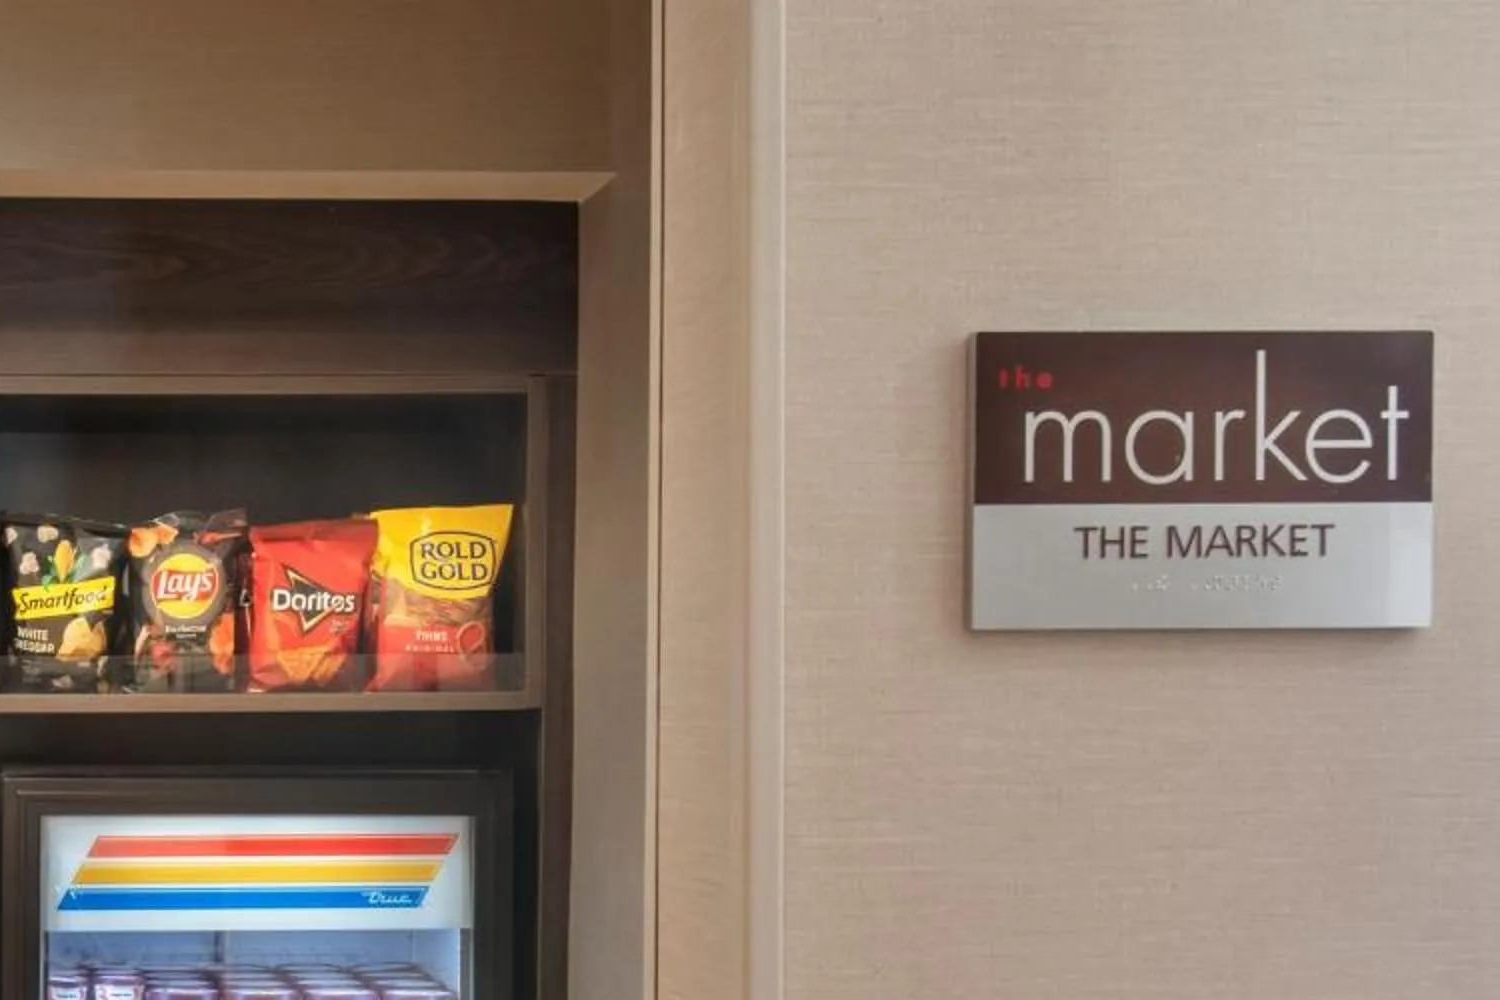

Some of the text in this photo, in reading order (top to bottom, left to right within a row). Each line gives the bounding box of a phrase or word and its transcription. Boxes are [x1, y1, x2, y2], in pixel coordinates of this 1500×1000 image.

[998, 366, 1054, 390] the
[1023, 349, 1410, 485] market
[420, 540, 487, 560] ROLD
[1073, 523, 1336, 560] THE MARKET
[420, 561, 488, 581] GOLD
[19, 584, 108, 614] Smartfood
[272, 588, 355, 613] Doritos
